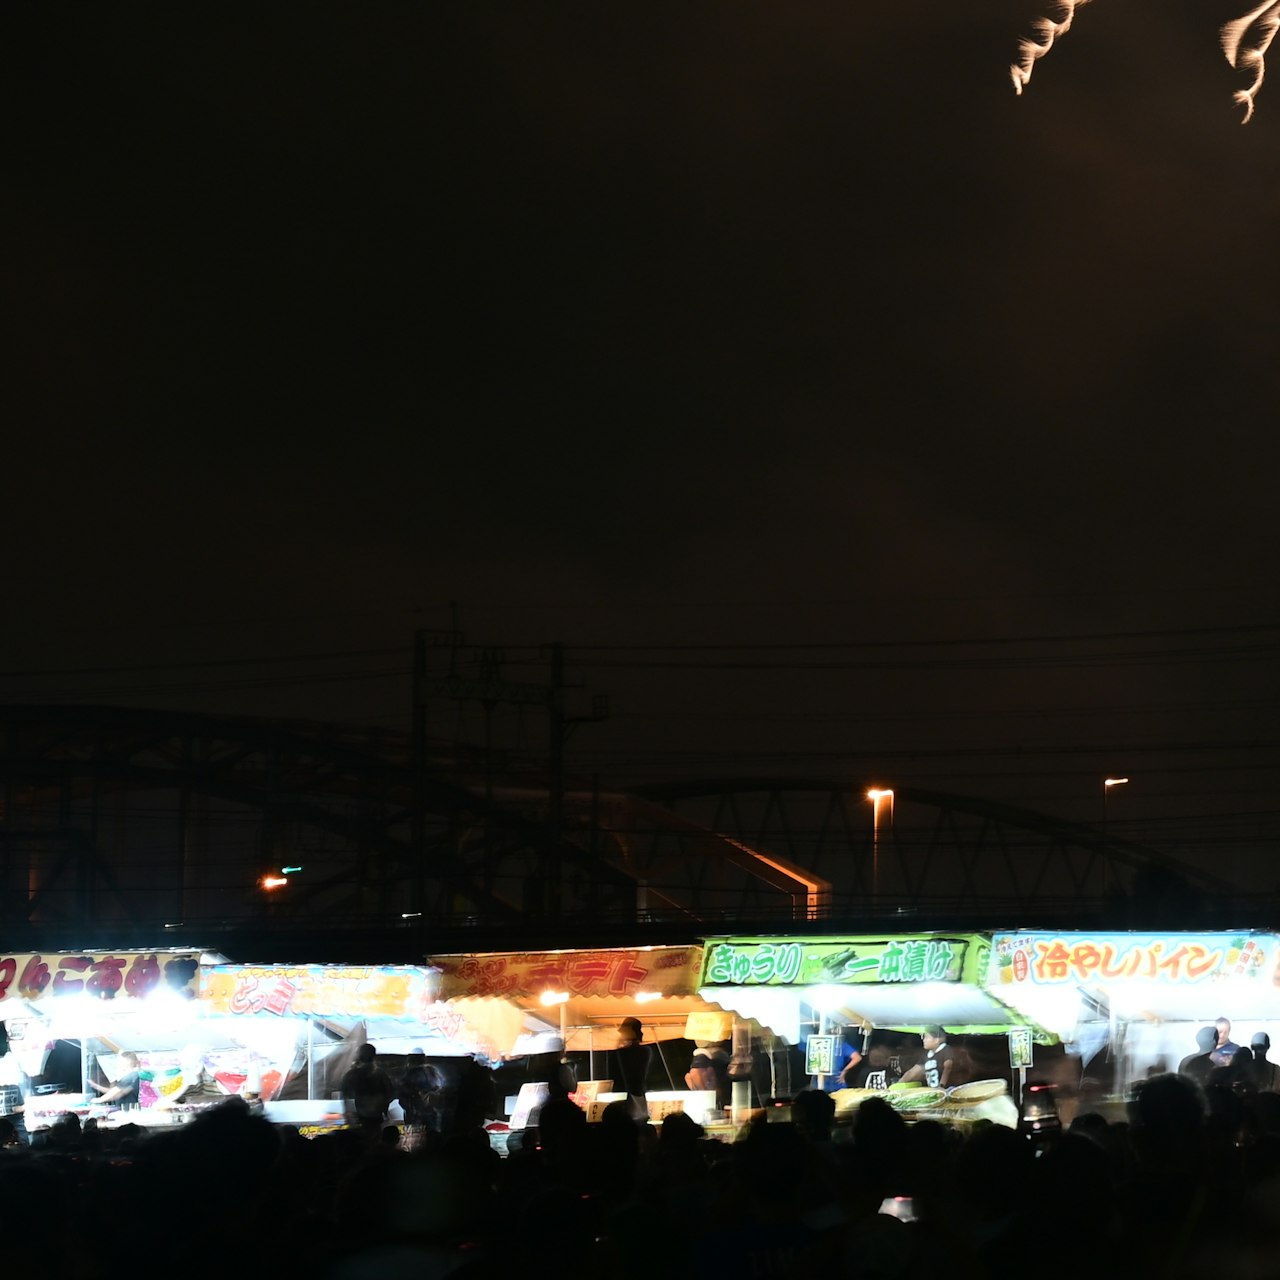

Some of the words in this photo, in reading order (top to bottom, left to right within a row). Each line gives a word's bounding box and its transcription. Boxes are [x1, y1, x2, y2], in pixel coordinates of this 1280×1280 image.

[710, 943, 801, 984] きゅうり
[845, 941, 954, 982] 一本漬け
[1035, 942, 1217, 979] 冷やしパイン
